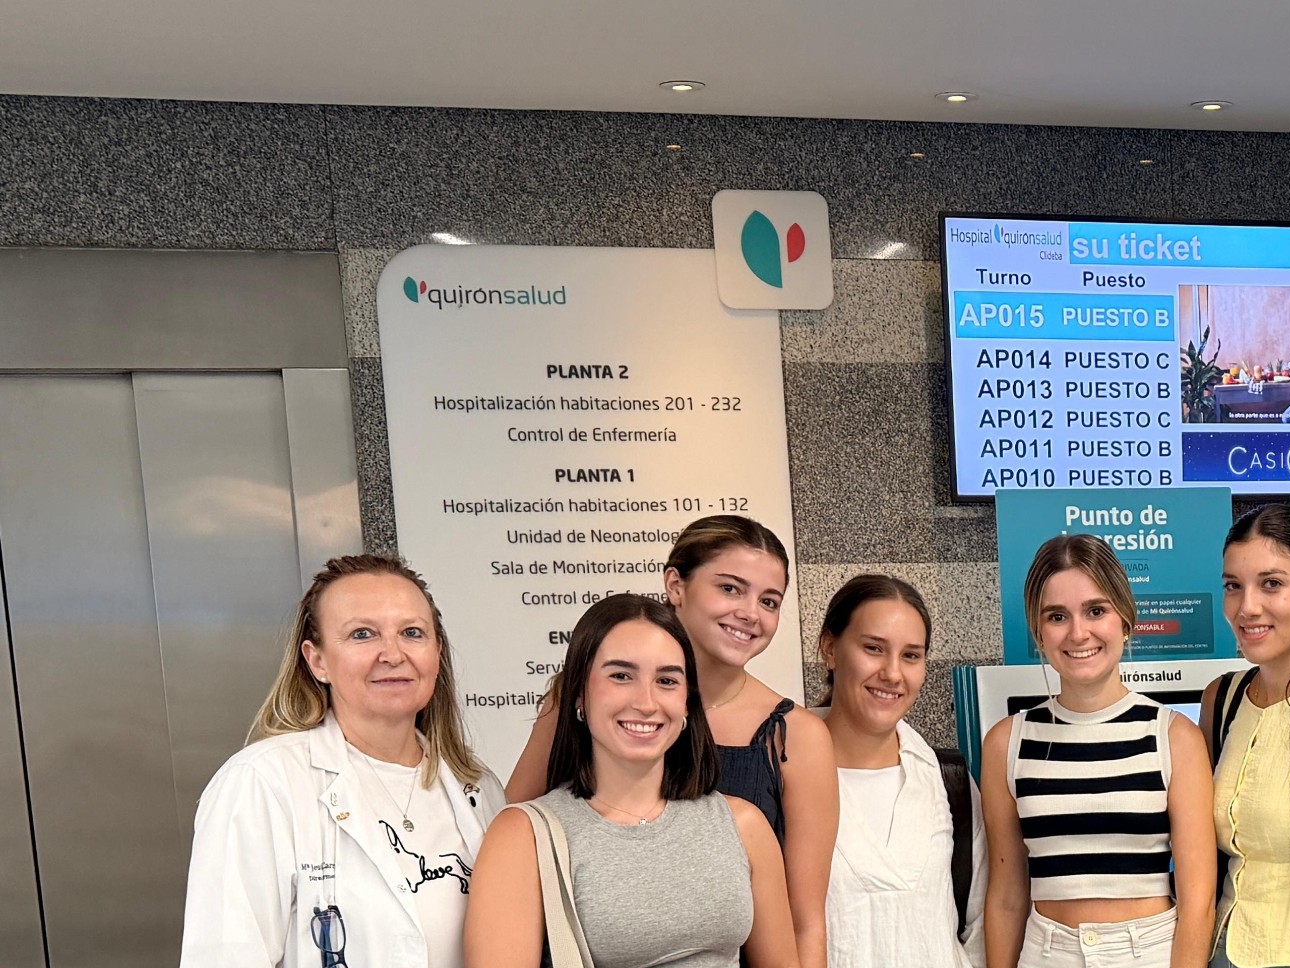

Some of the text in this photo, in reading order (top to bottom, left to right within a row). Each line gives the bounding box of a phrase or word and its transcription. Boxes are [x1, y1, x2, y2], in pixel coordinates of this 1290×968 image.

[950, 227, 993, 247] Hospital
[1072, 232, 1202, 261] su ticket
[975, 268, 1146, 288] Turno Puesto
[427, 285, 567, 310] quirónsalud
[958, 303, 1170, 328] AP015 PUESTO B
[976, 348, 1170, 370] AP014 PUESTO C
[546, 364, 630, 380] PLANTA 2
[977, 379, 1171, 399] AP013 PUESTO B
[433, 393, 557, 413] Hospitalización
[560, 395, 661, 411] habitaciones
[664, 396, 695, 411] 201
[710, 396, 742, 411] 232
[978, 409, 1171, 429] AP012 PUESTO C
[507, 426, 677, 442] Control de Enfermería
[979, 438, 1172, 459] AP011 PUESTO B
[554, 467, 636, 483] PLANTA 1
[981, 468, 1173, 489] AP010 PUESTO B
[442, 496, 565, 517] Hospitalización
[568, 496, 668, 513] habitaciones
[672, 497, 705, 512] 101
[718, 497, 749, 512] 132
[1065, 504, 1168, 526] Punto de
[506, 528, 683, 545] Unidad de Neonatolog
[1062, 529, 1173, 550] resión
[490, 558, 666, 576] Sala de Monitorización
[1122, 562, 1150, 572] IVADA
[521, 589, 578, 606] Control
[581, 590, 600, 605] de
[1133, 623, 1165, 631] PONSABLE
[525, 660, 567, 675] Servi
[1120, 669, 1182, 683] irónsalud
[465, 691, 544, 709] Hospitaliz
[419, 855, 454, 881] love
